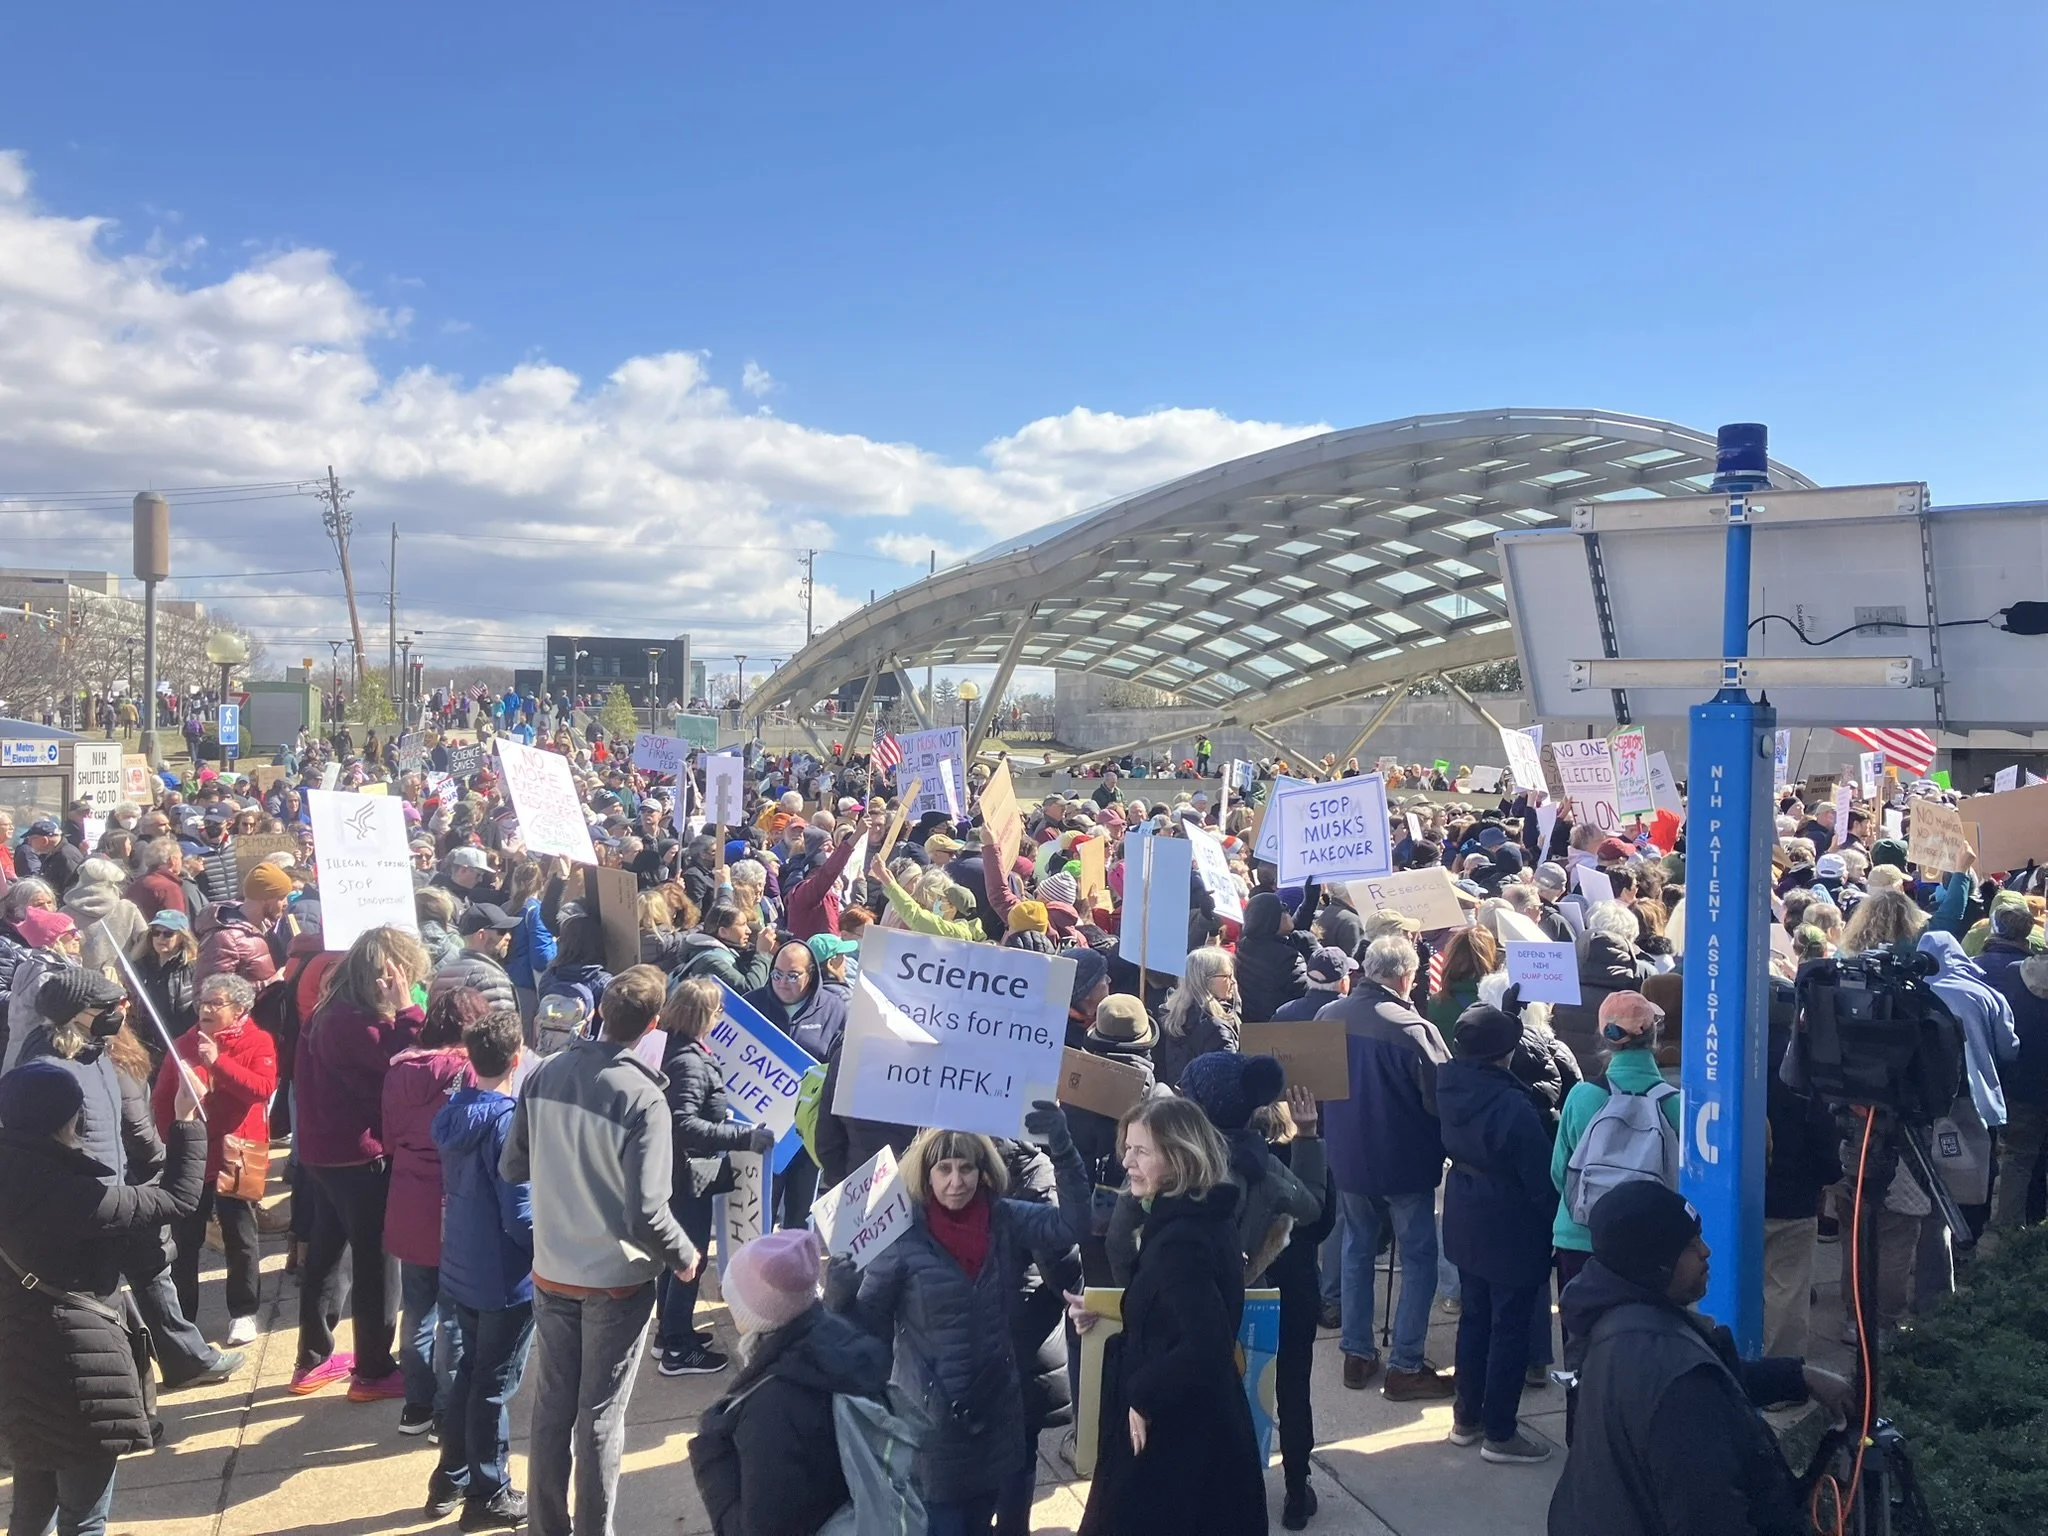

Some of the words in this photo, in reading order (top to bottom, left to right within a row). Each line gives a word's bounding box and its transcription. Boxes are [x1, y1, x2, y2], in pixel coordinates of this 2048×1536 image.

[16, 743, 34, 751] Metro
[641, 735, 669, 749] STOP
[940, 731, 958, 747] NOT
[452, 746, 480, 762] SCIENCE
[649, 749, 674, 761] FIRING
[1554, 744, 1574, 757] NO
[1580, 741, 1608, 756] ONE
[12, 754, 38, 763] Elevator
[92, 752, 107, 765] NIH
[453, 759, 476, 771] SAVES
[521, 749, 544, 769] NO
[660, 760, 677, 770] FEDS
[78, 771, 106, 785] SHUTTLE
[107, 770, 119, 784] BUS
[513, 764, 562, 789] MORE
[1561, 768, 1612, 783] ELECTED
[1711, 765, 1723, 808] NIH
[97, 790, 107, 804] GO
[108, 790, 117, 803] TO
[1310, 796, 1349, 819] STOP
[1916, 806, 1933, 826] NO
[1304, 816, 1364, 844] MUSK'S
[1300, 840, 1373, 864] TAKEOVER
[326, 858, 367, 869] ILLEGAL
[1709, 820, 1721, 922] PATIENT
[338, 878, 373, 894] STOP
[1518, 951, 1545, 959] DEFEND
[897, 953, 1029, 999] Science
[1544, 973, 1563, 981] DOGE
[1706, 934, 1719, 1081] ASSISTANCE
[889, 1000, 959, 1030] eaks
[968, 1011, 1003, 1037] for
[1009, 1022, 1054, 1049] me,
[740, 1045, 799, 1097] SAVED
[887, 1063, 932, 1086] not
[726, 1072, 773, 1113] LIFE
[745, 1165, 761, 1241] SAV
